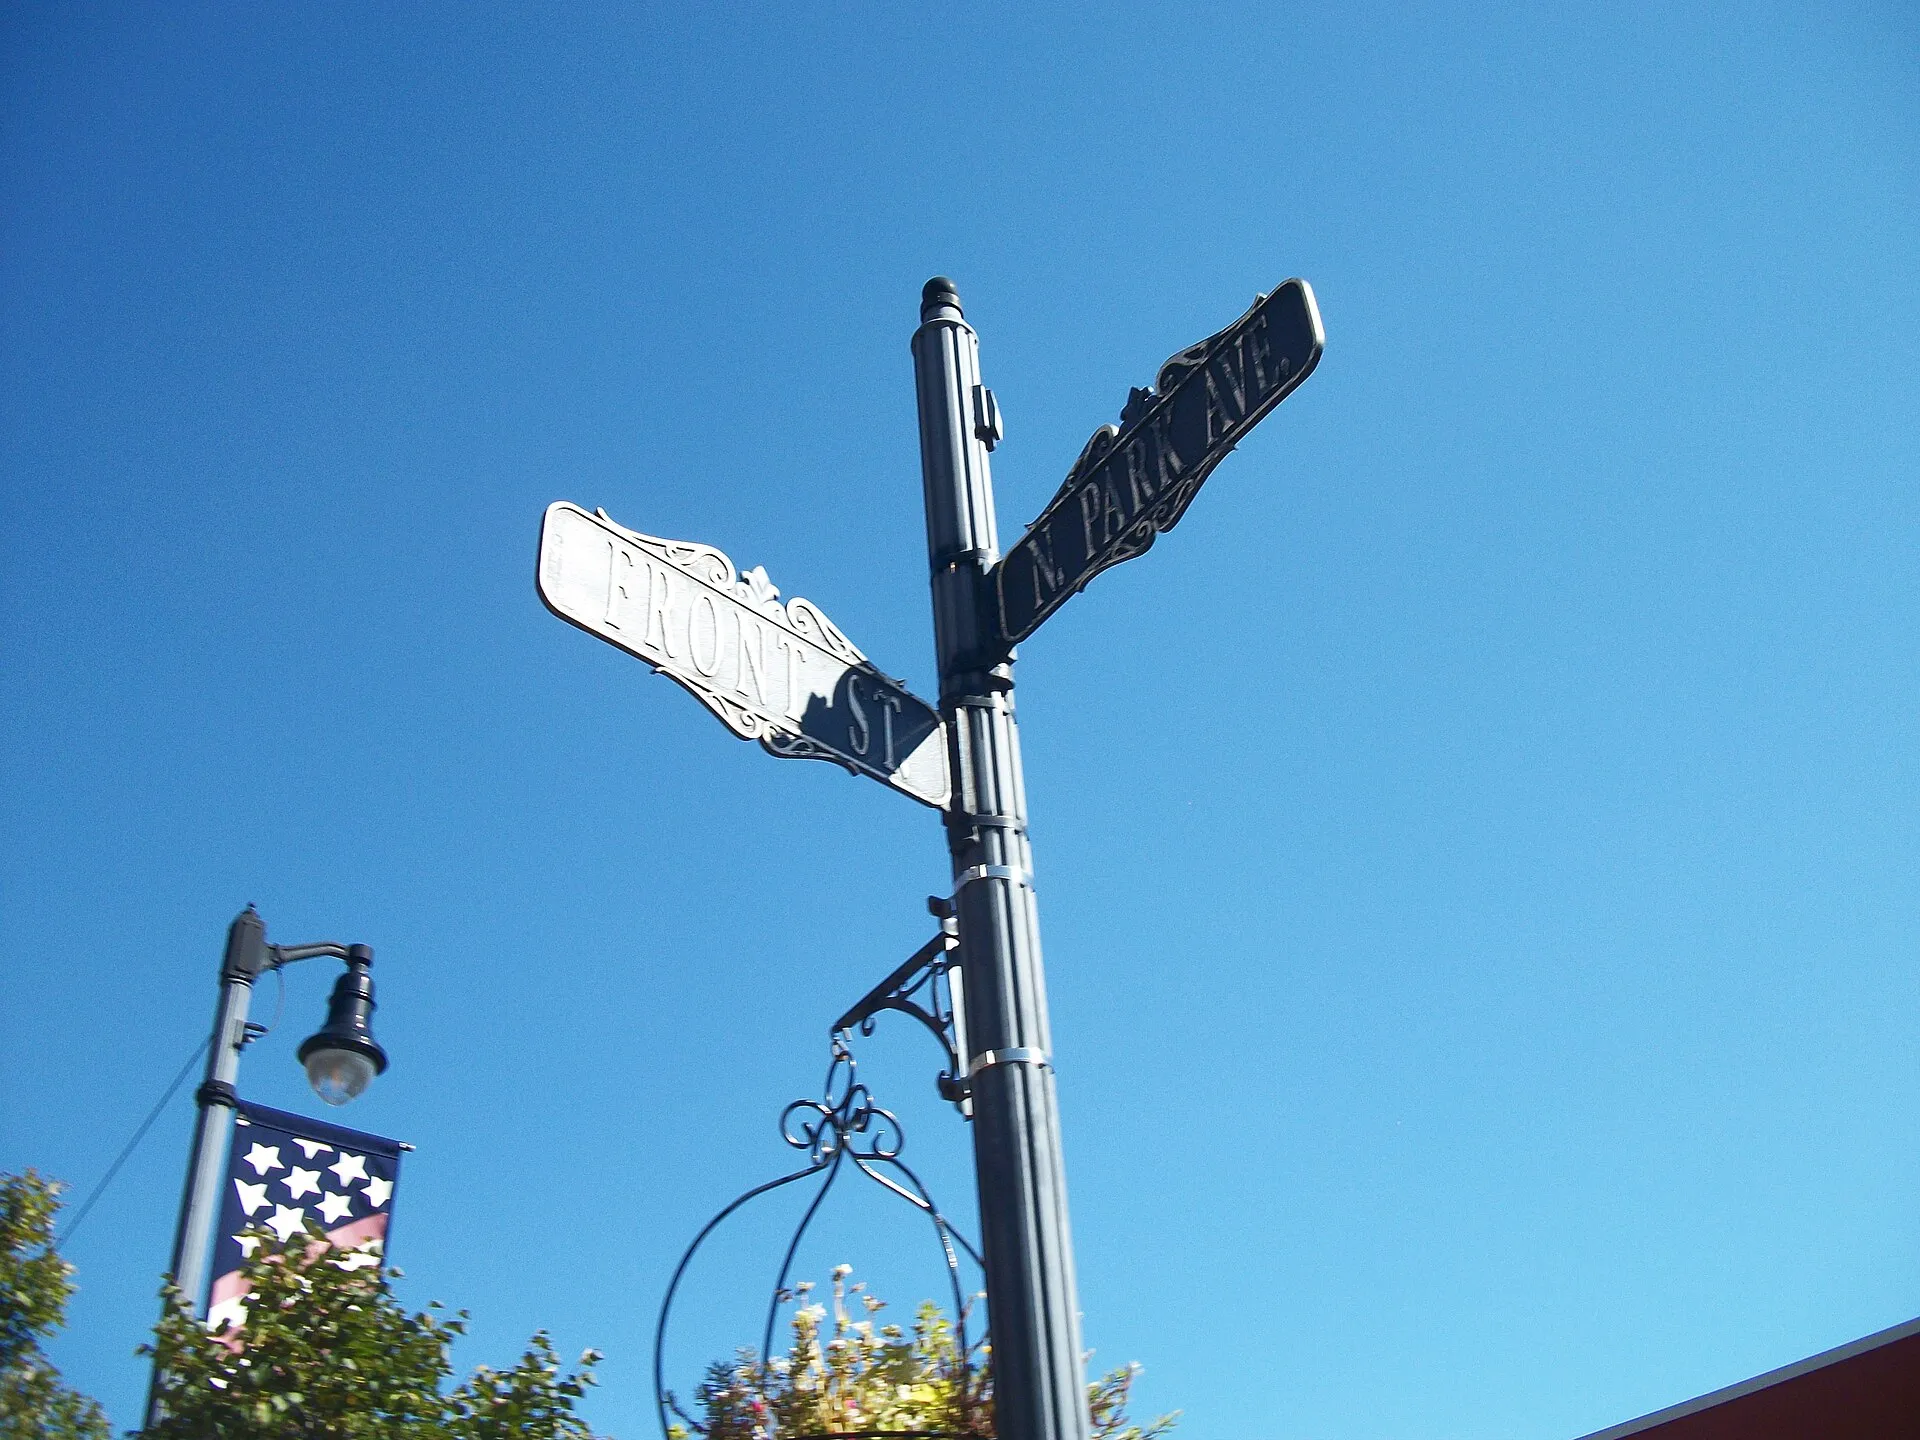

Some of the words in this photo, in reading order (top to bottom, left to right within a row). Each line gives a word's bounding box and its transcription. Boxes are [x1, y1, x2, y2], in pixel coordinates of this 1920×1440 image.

[1026, 522, 1065, 610] N.
[1078, 401, 1187, 560] PARK
[1206, 313, 1291, 448] AVE.
[603, 541, 807, 723] FRONT
